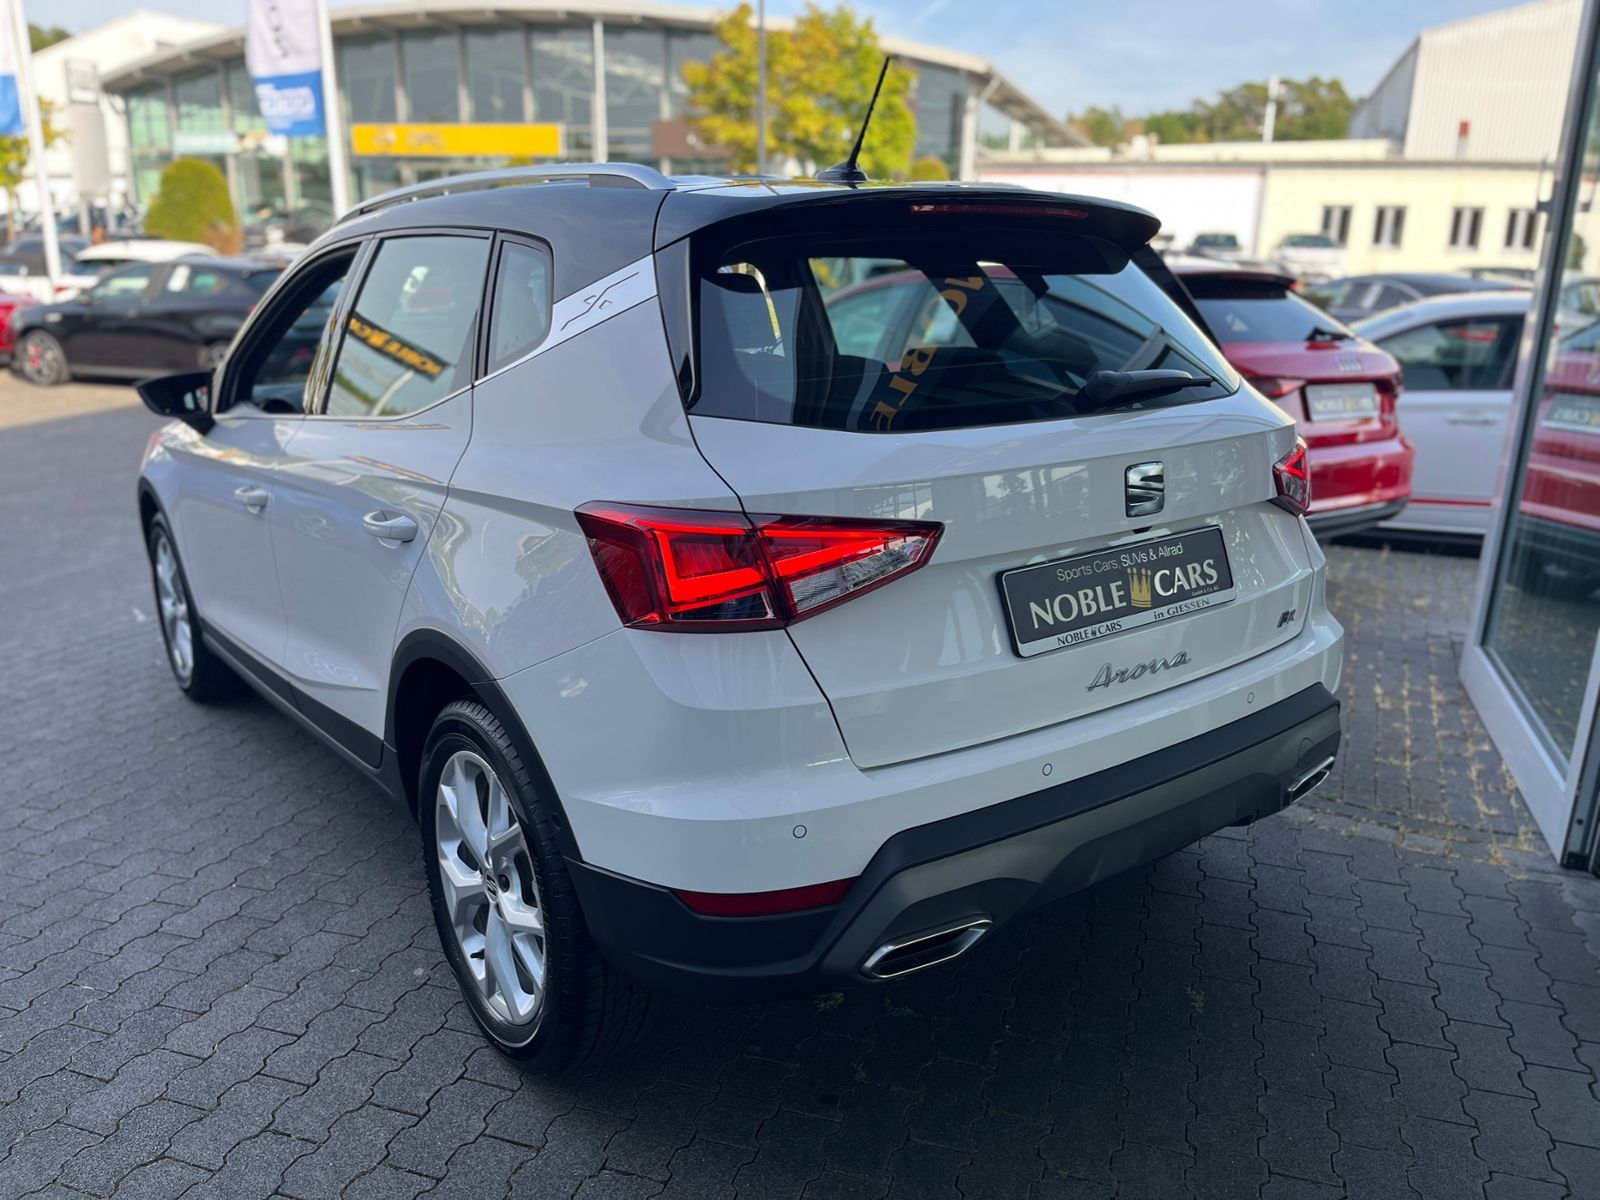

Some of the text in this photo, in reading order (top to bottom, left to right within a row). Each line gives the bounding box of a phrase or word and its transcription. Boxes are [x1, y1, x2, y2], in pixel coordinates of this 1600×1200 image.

[1056, 542, 1183, 582] Sports Cars, SUVs & Allrad
[1029, 559, 1219, 629] NOBLE CARS
[1153, 598, 1210, 620] in GIESSEN
[1057, 620, 1122, 647] NOBLE CARS
[1086, 650, 1192, 692] Arona
